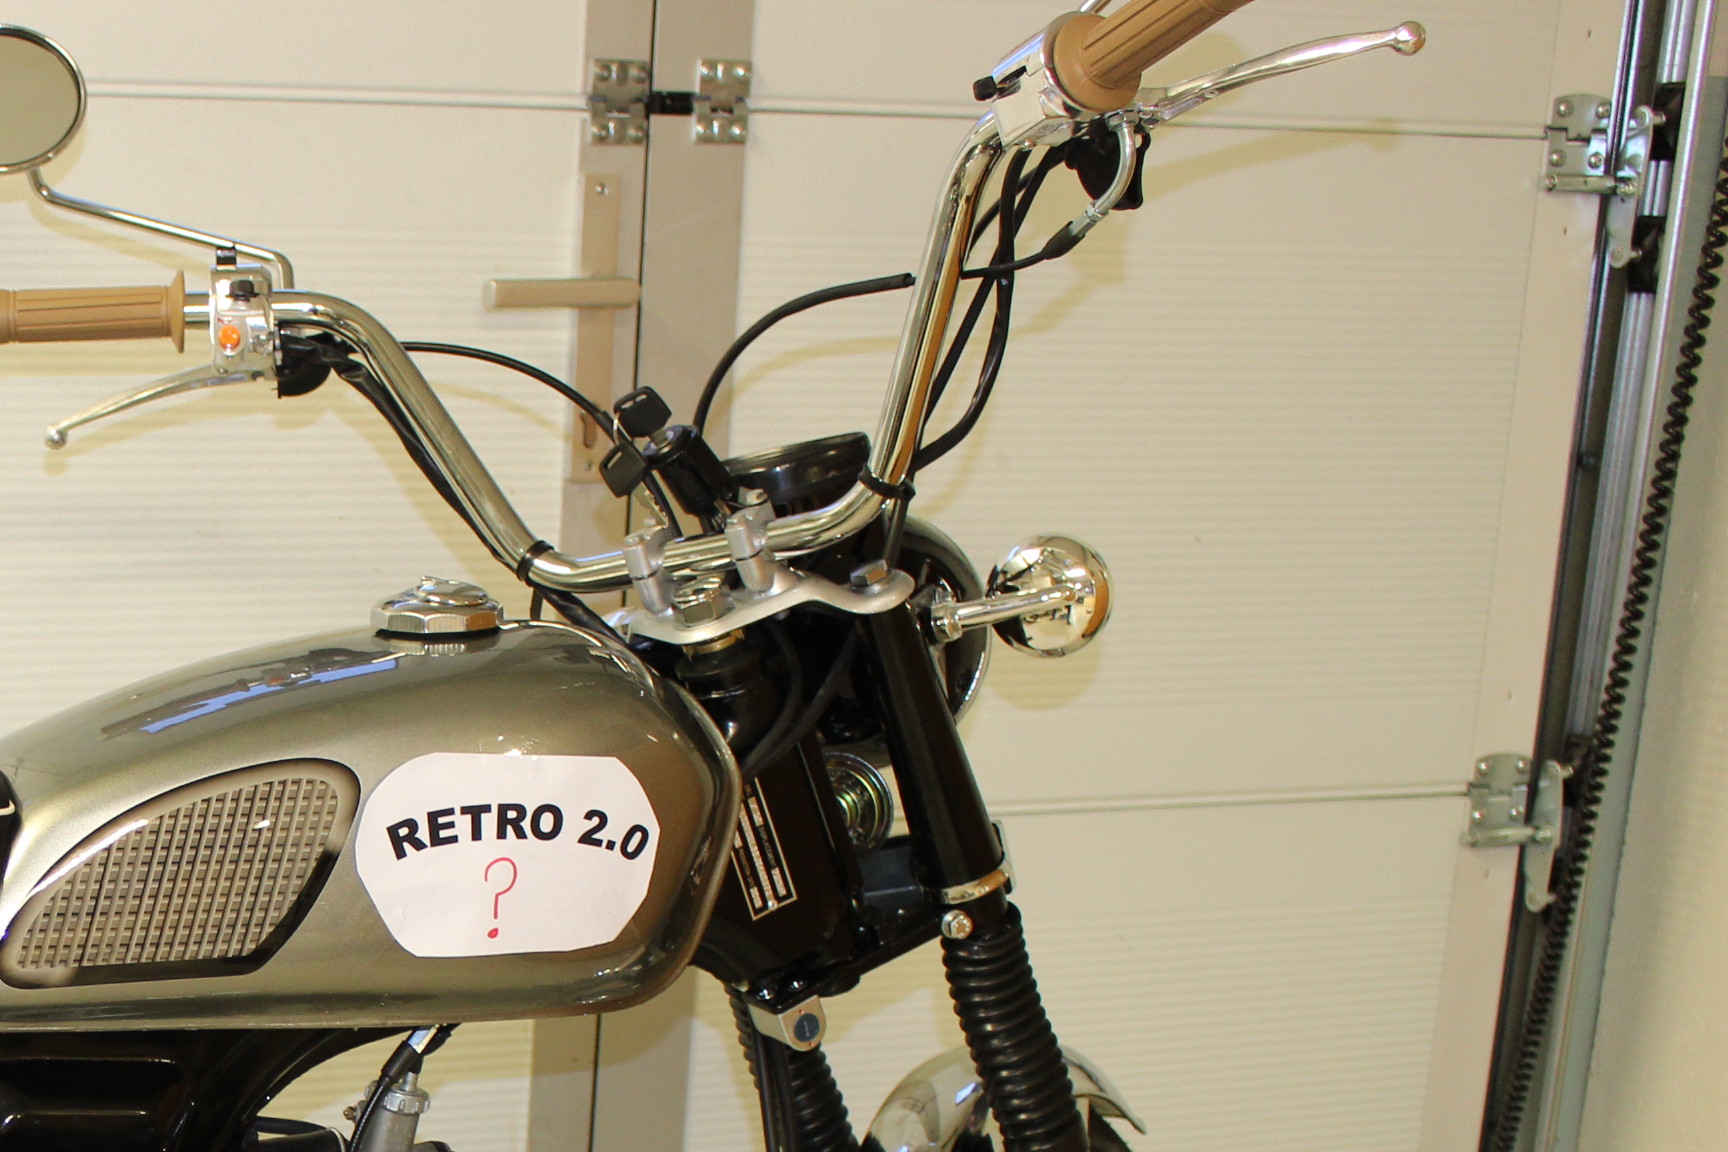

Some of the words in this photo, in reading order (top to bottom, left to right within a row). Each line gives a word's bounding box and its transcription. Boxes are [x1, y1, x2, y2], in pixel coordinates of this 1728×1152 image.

[386, 803, 564, 860] RETRO
[577, 809, 650, 860] 2.0
[484, 856, 518, 939] ?
